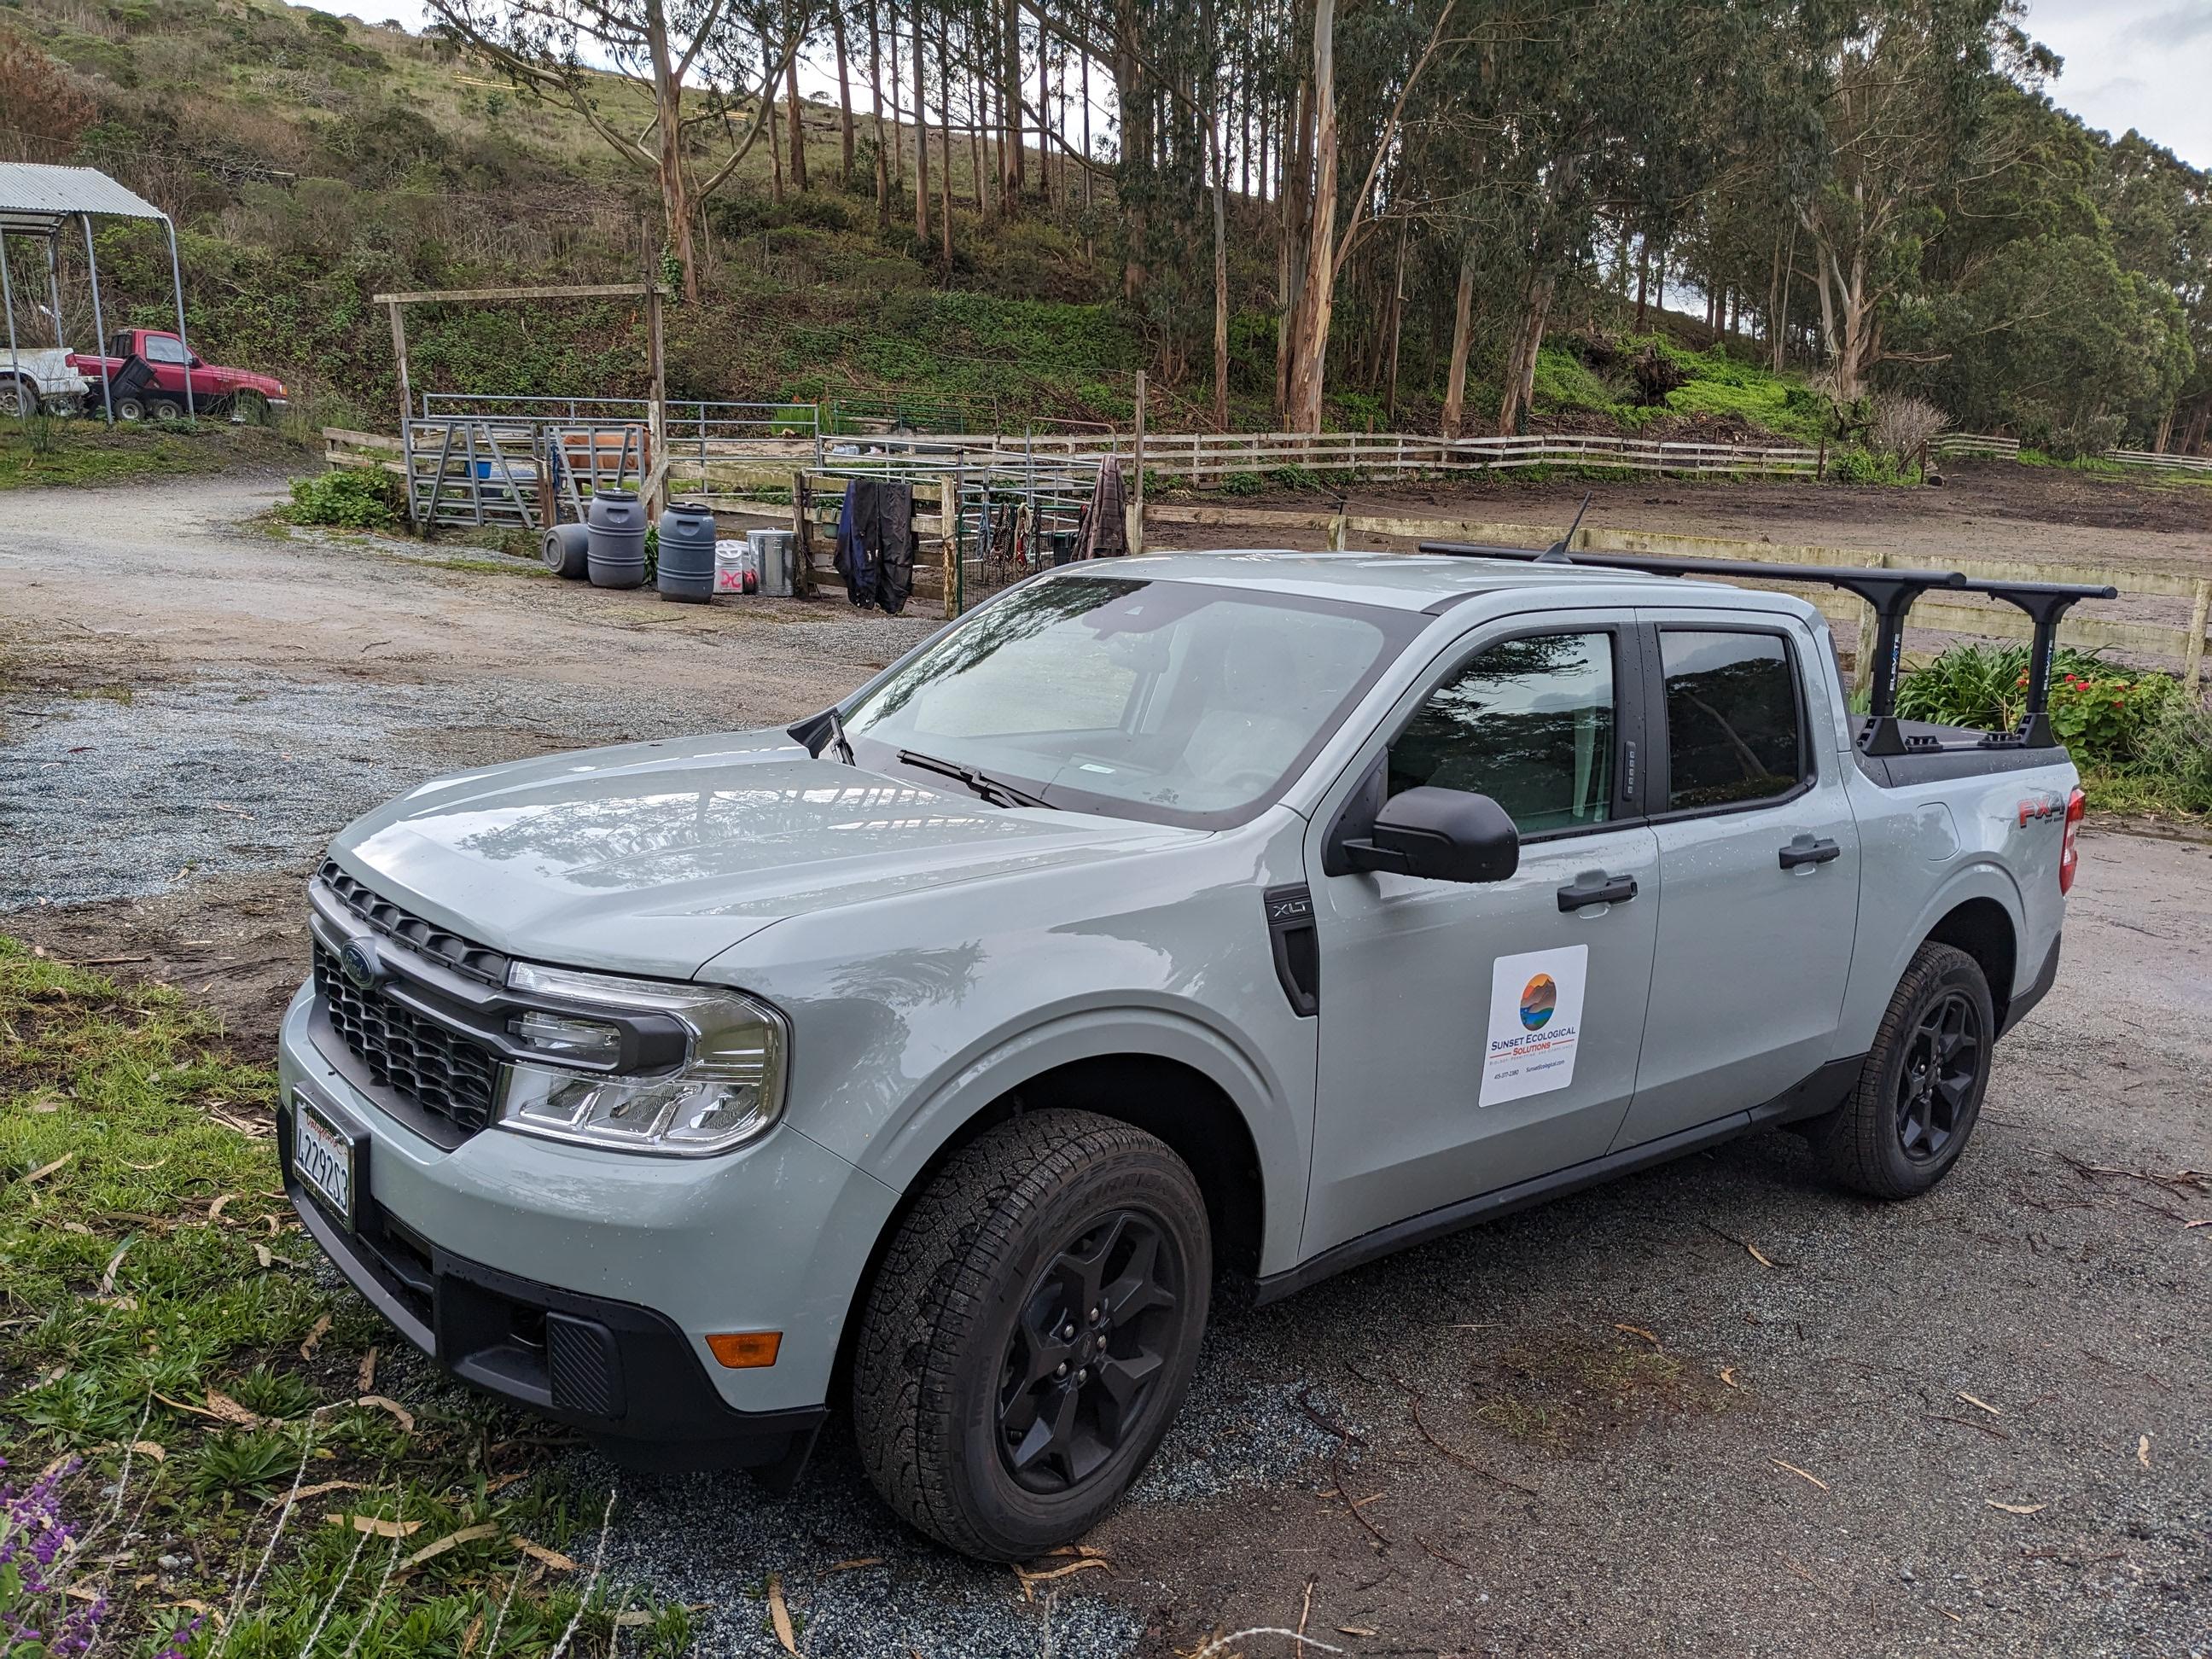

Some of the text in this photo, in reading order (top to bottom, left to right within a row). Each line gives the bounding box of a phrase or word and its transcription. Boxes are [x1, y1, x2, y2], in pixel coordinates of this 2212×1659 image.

[2017, 790, 2065, 829] FX4
[1272, 900, 1310, 917] XLT
[1492, 1027, 1575, 1051] SUNSET ECOLOGICAL
[1513, 1042, 1551, 1056] SOLUTIONS
[298, 1126, 348, 1210] 42292S3
